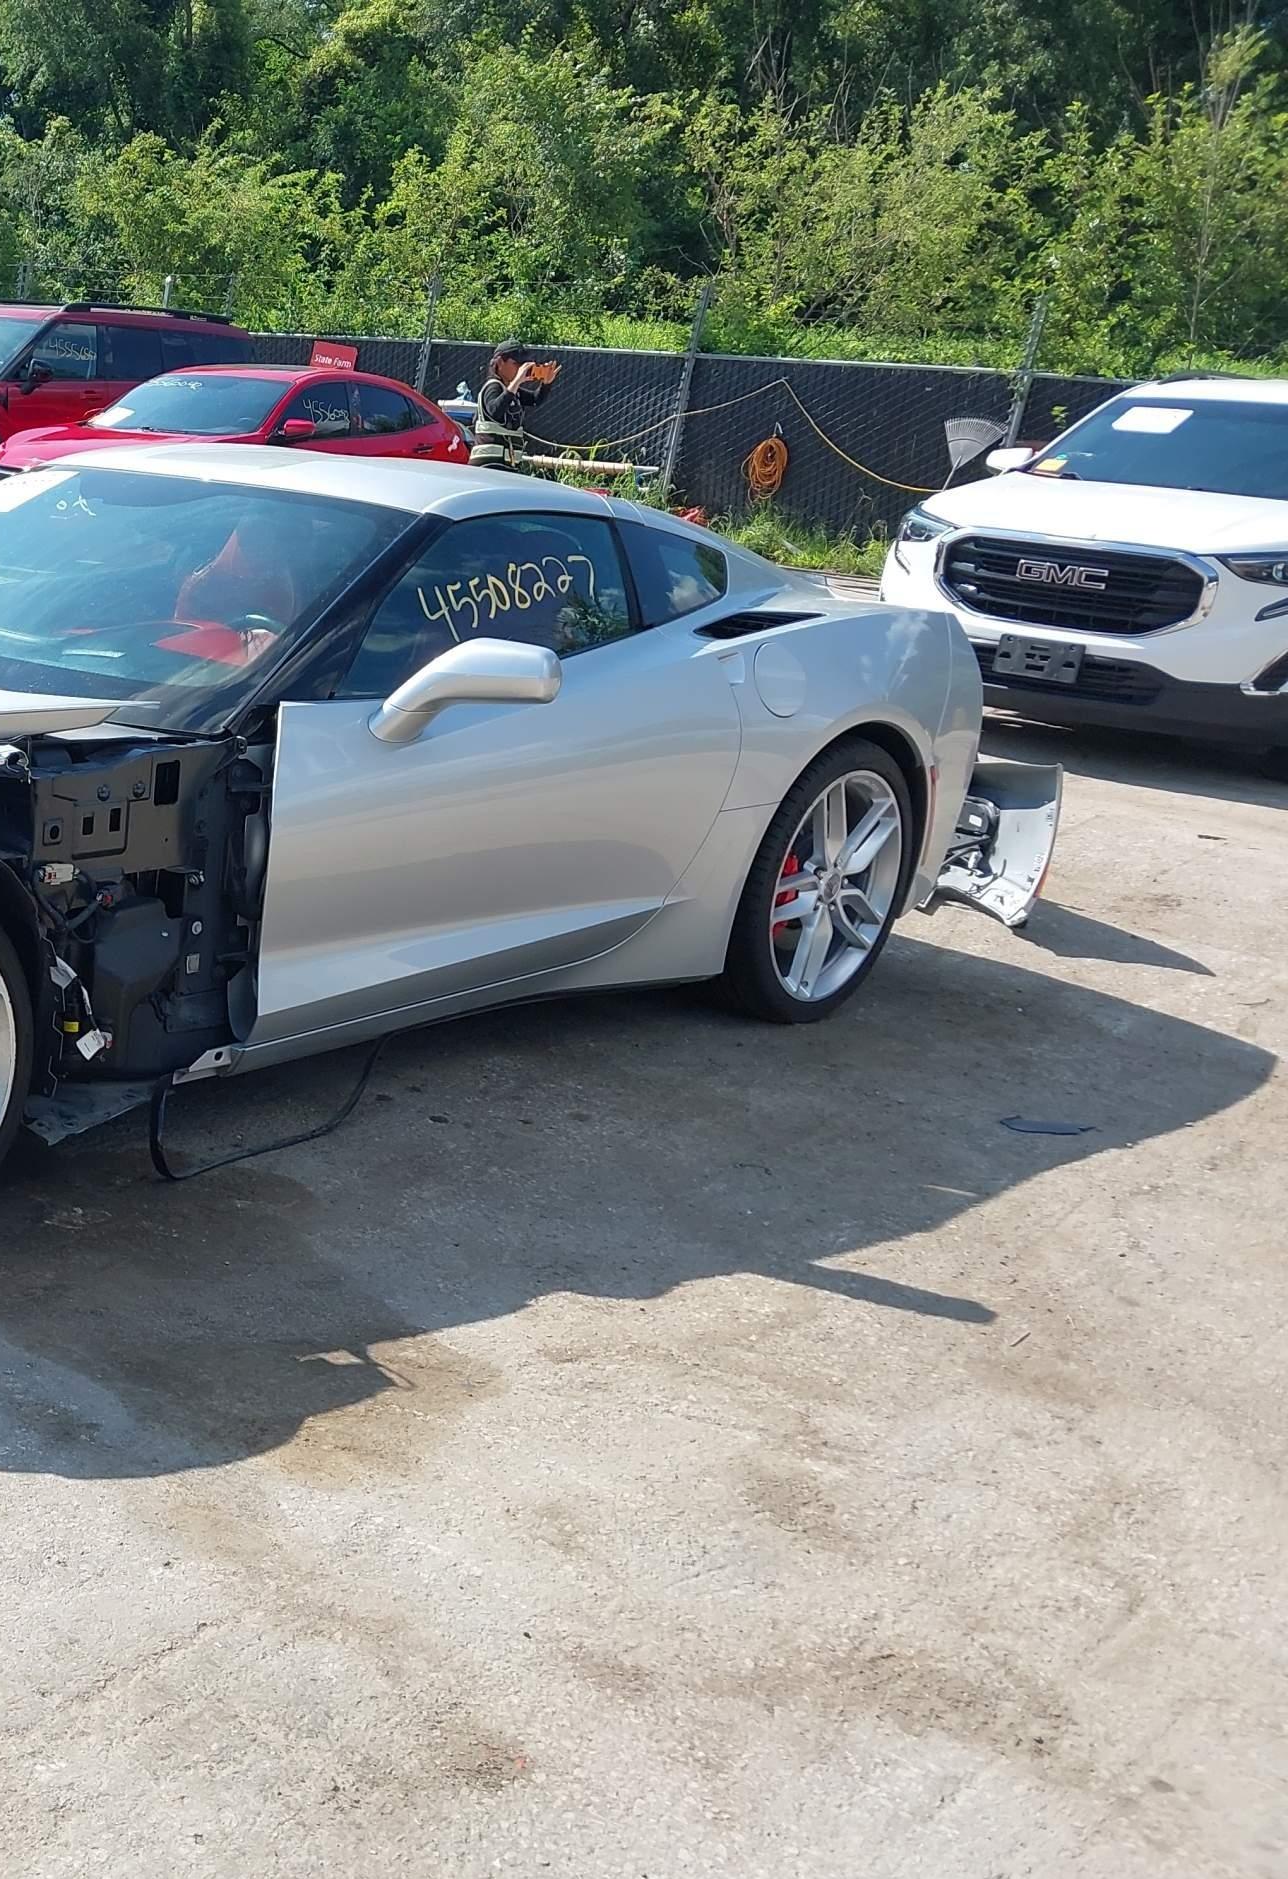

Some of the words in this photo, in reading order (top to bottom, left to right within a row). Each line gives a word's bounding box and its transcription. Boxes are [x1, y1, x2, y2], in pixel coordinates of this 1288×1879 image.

[314, 353, 333, 365] State
[333, 356, 352, 368] Farm
[1015, 559, 1109, 590] GMC
[417, 555, 596, 642] 45508227
